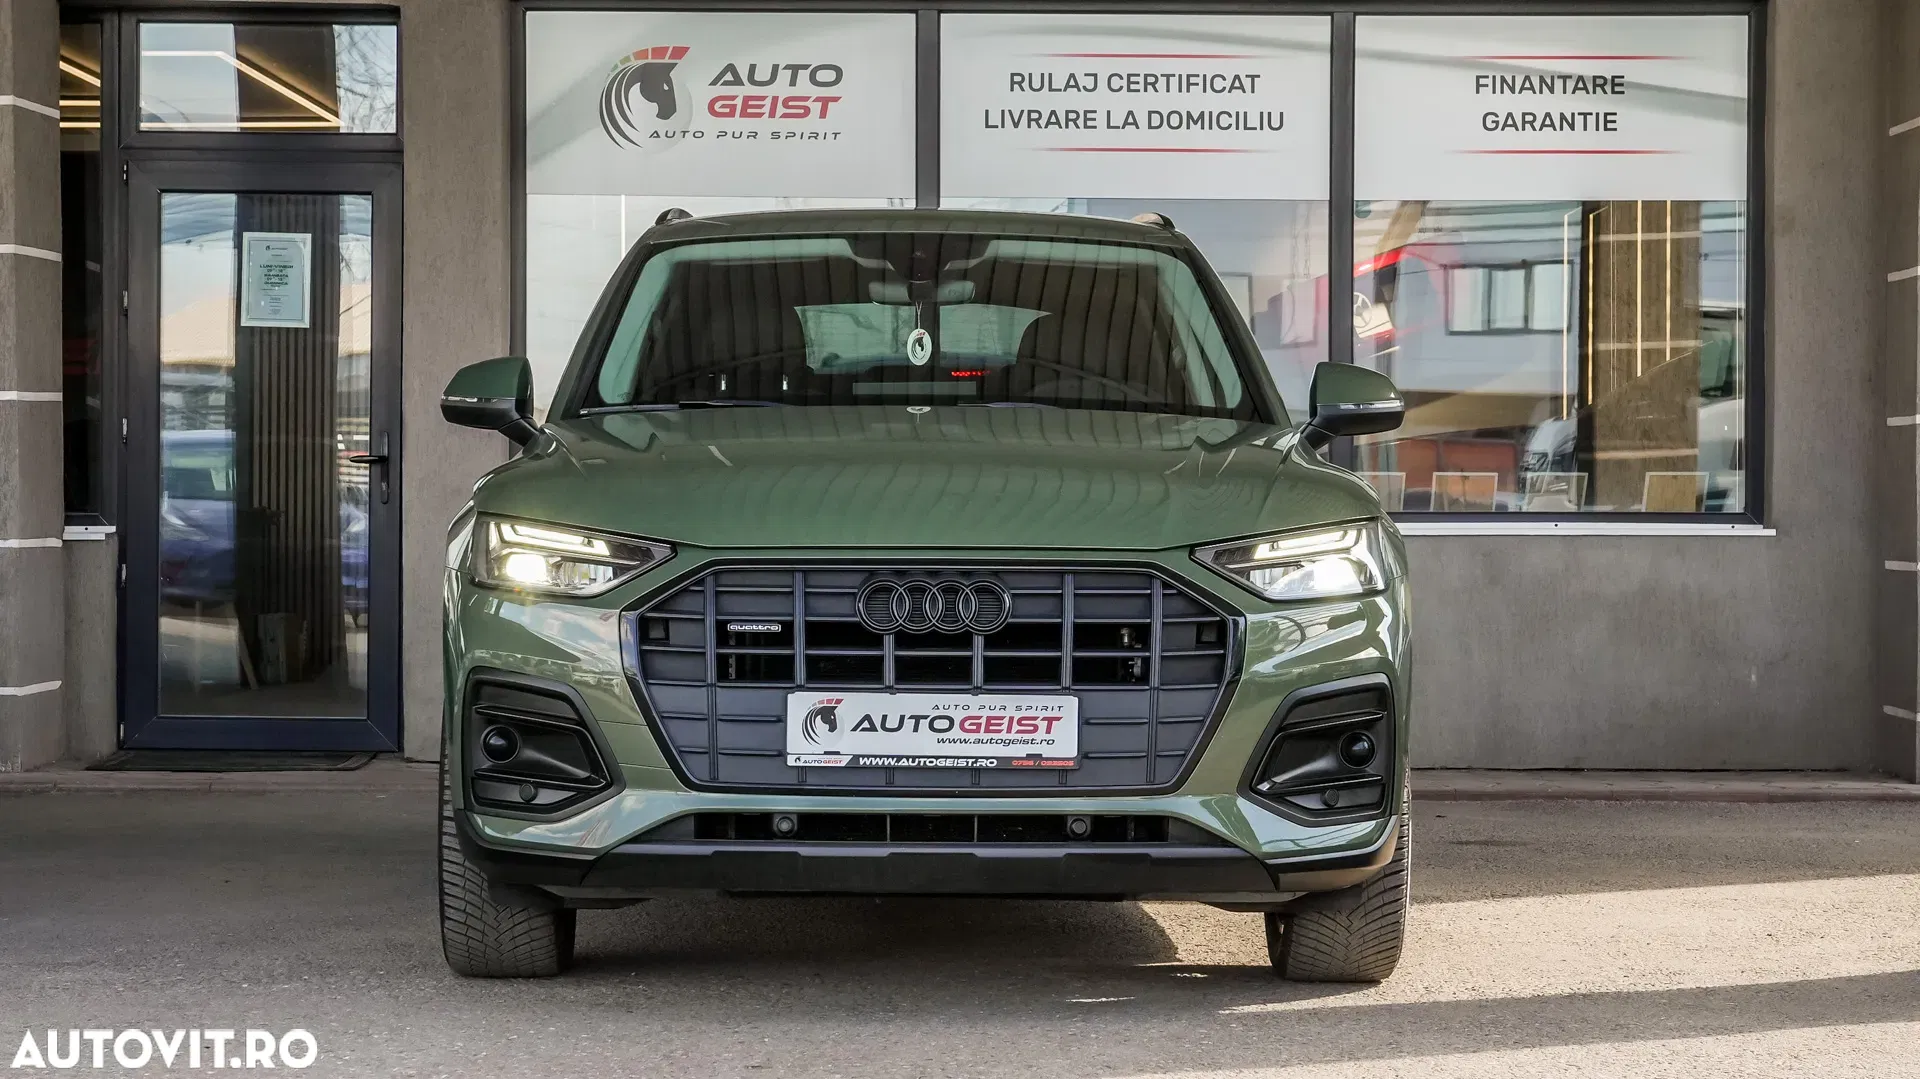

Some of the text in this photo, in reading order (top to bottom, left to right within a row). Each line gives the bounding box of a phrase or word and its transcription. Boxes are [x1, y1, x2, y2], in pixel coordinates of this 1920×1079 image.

[708, 63, 843, 87] AUTO
[1009, 73, 1261, 94] RULAJ CERTIFICAT
[1475, 75, 1625, 95] FINANTARE
[707, 95, 842, 119] GEIST
[984, 109, 1284, 131] LIVRARE LA DOMICILIU
[1482, 112, 1618, 132] GARANTIE
[648, 130, 842, 140] AUTO PUR SPIRIT
[936, 737, 1056, 747] www.autogeist.ro
[858, 757, 998, 768] WWW.AUTOGEIST.RO
